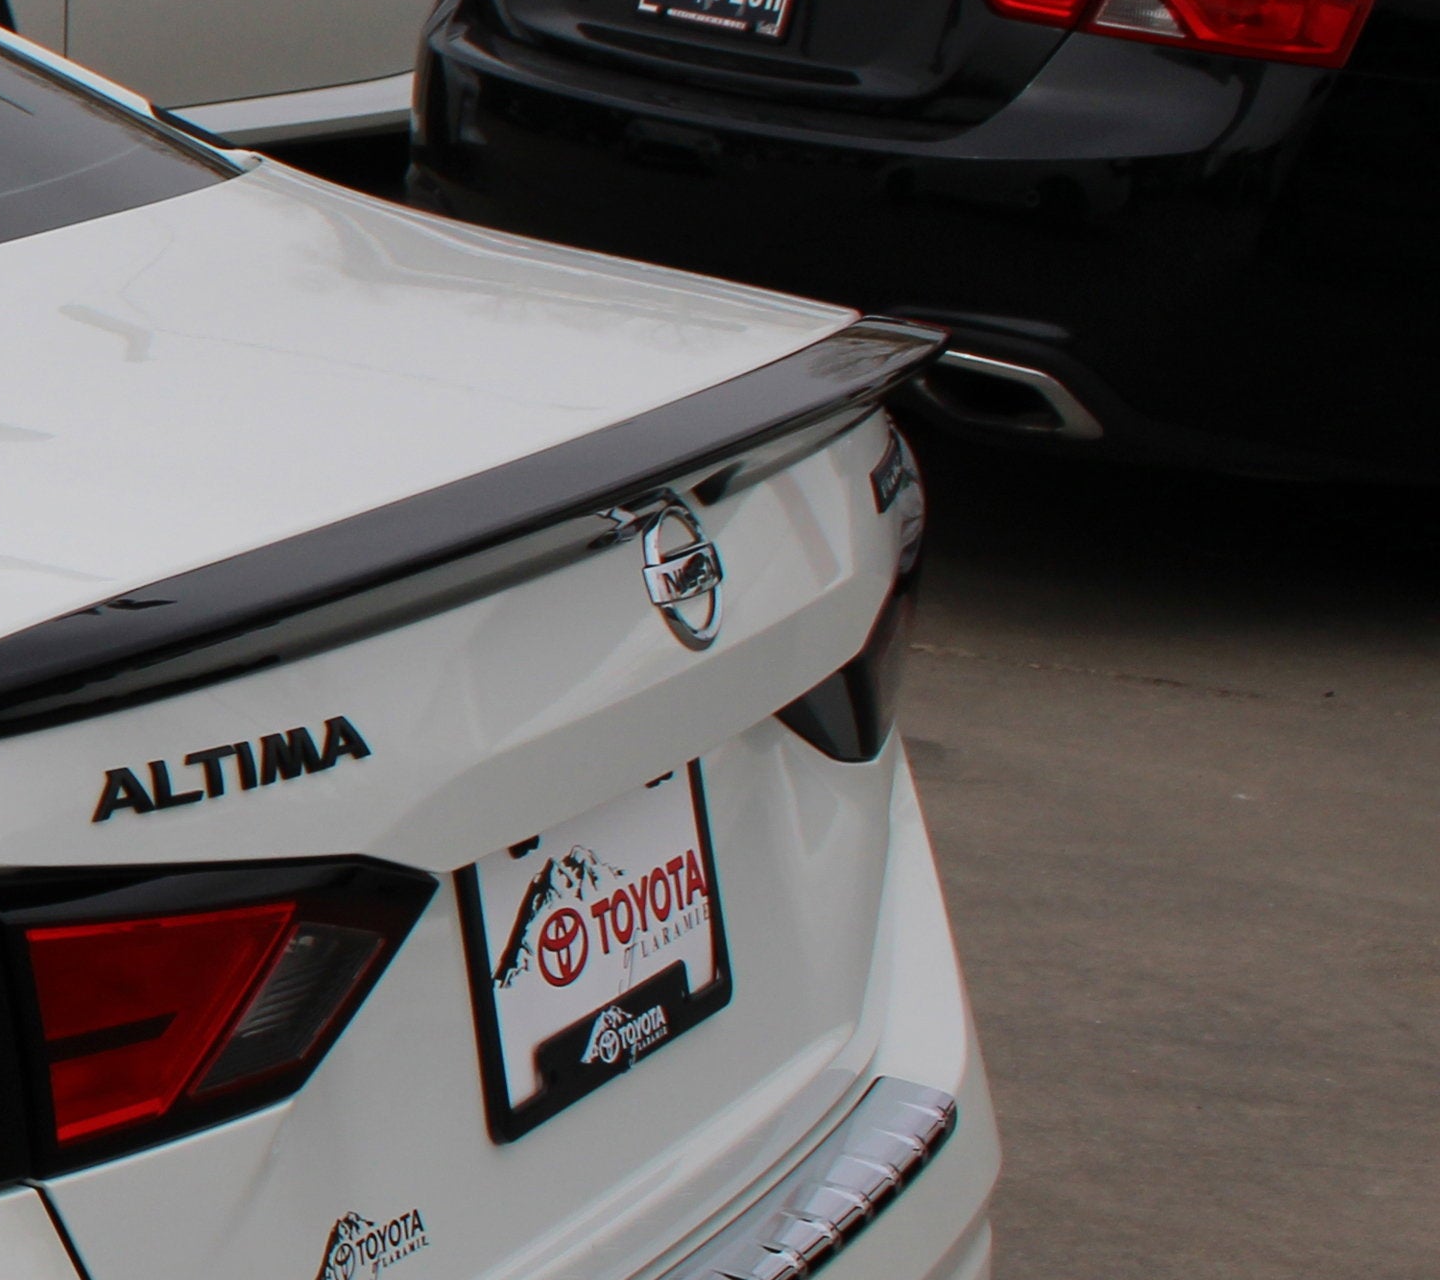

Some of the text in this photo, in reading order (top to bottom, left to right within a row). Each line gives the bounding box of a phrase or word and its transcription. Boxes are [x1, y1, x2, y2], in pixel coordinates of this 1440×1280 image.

[91, 716, 372, 823] ALTIMA
[590, 849, 709, 954] TOYOTA
[639, 901, 712, 958] LARAMIE
[618, 1005, 666, 1049] TOYOTA
[356, 1209, 424, 1265] TOYOTA
